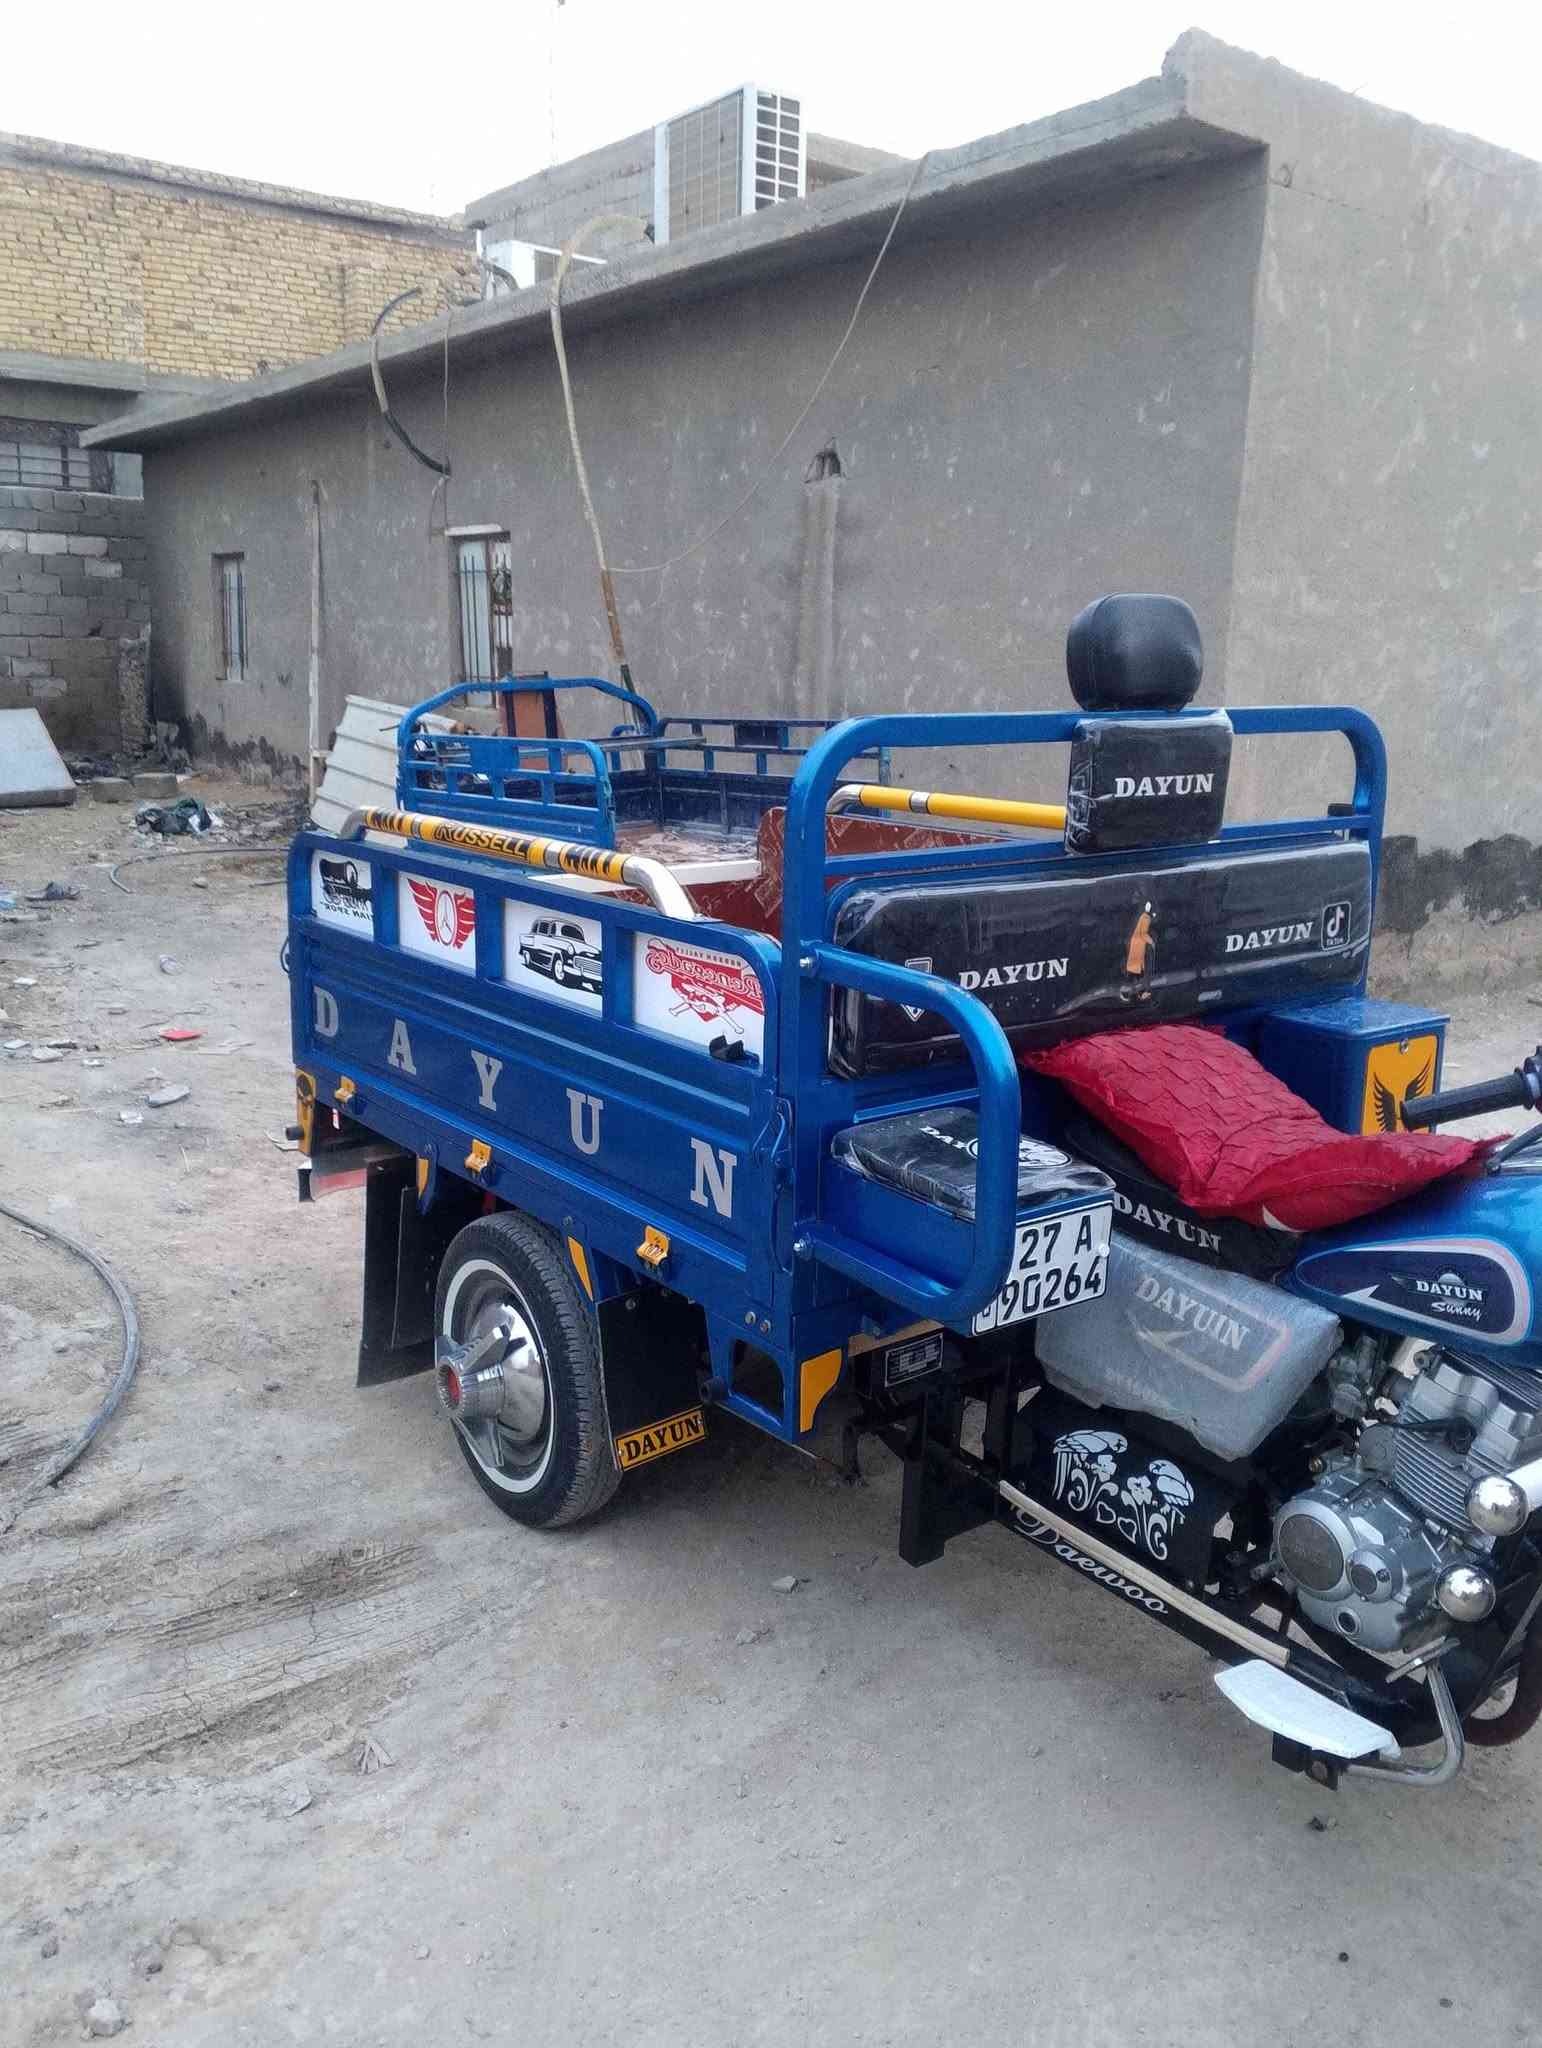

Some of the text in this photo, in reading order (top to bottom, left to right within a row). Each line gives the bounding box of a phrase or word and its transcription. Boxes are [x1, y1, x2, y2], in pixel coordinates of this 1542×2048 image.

[1113, 773, 1216, 798] DAYUN
[434, 822, 529, 857] RUSSELL
[1224, 921, 1314, 953] DAYUN
[958, 957, 1070, 991] DAYUN
[1112, 1190, 1222, 1253] DAYUN
[1019, 1214, 1093, 1270] 27 A
[1001, 1255, 1102, 1321] 90264
[1415, 1279, 1484, 1302] DAYUN
[1431, 1300, 1483, 1321] Sunny
[624, 1412, 703, 1460] DAYUN
[1010, 1503, 1169, 1615] Daewoo
